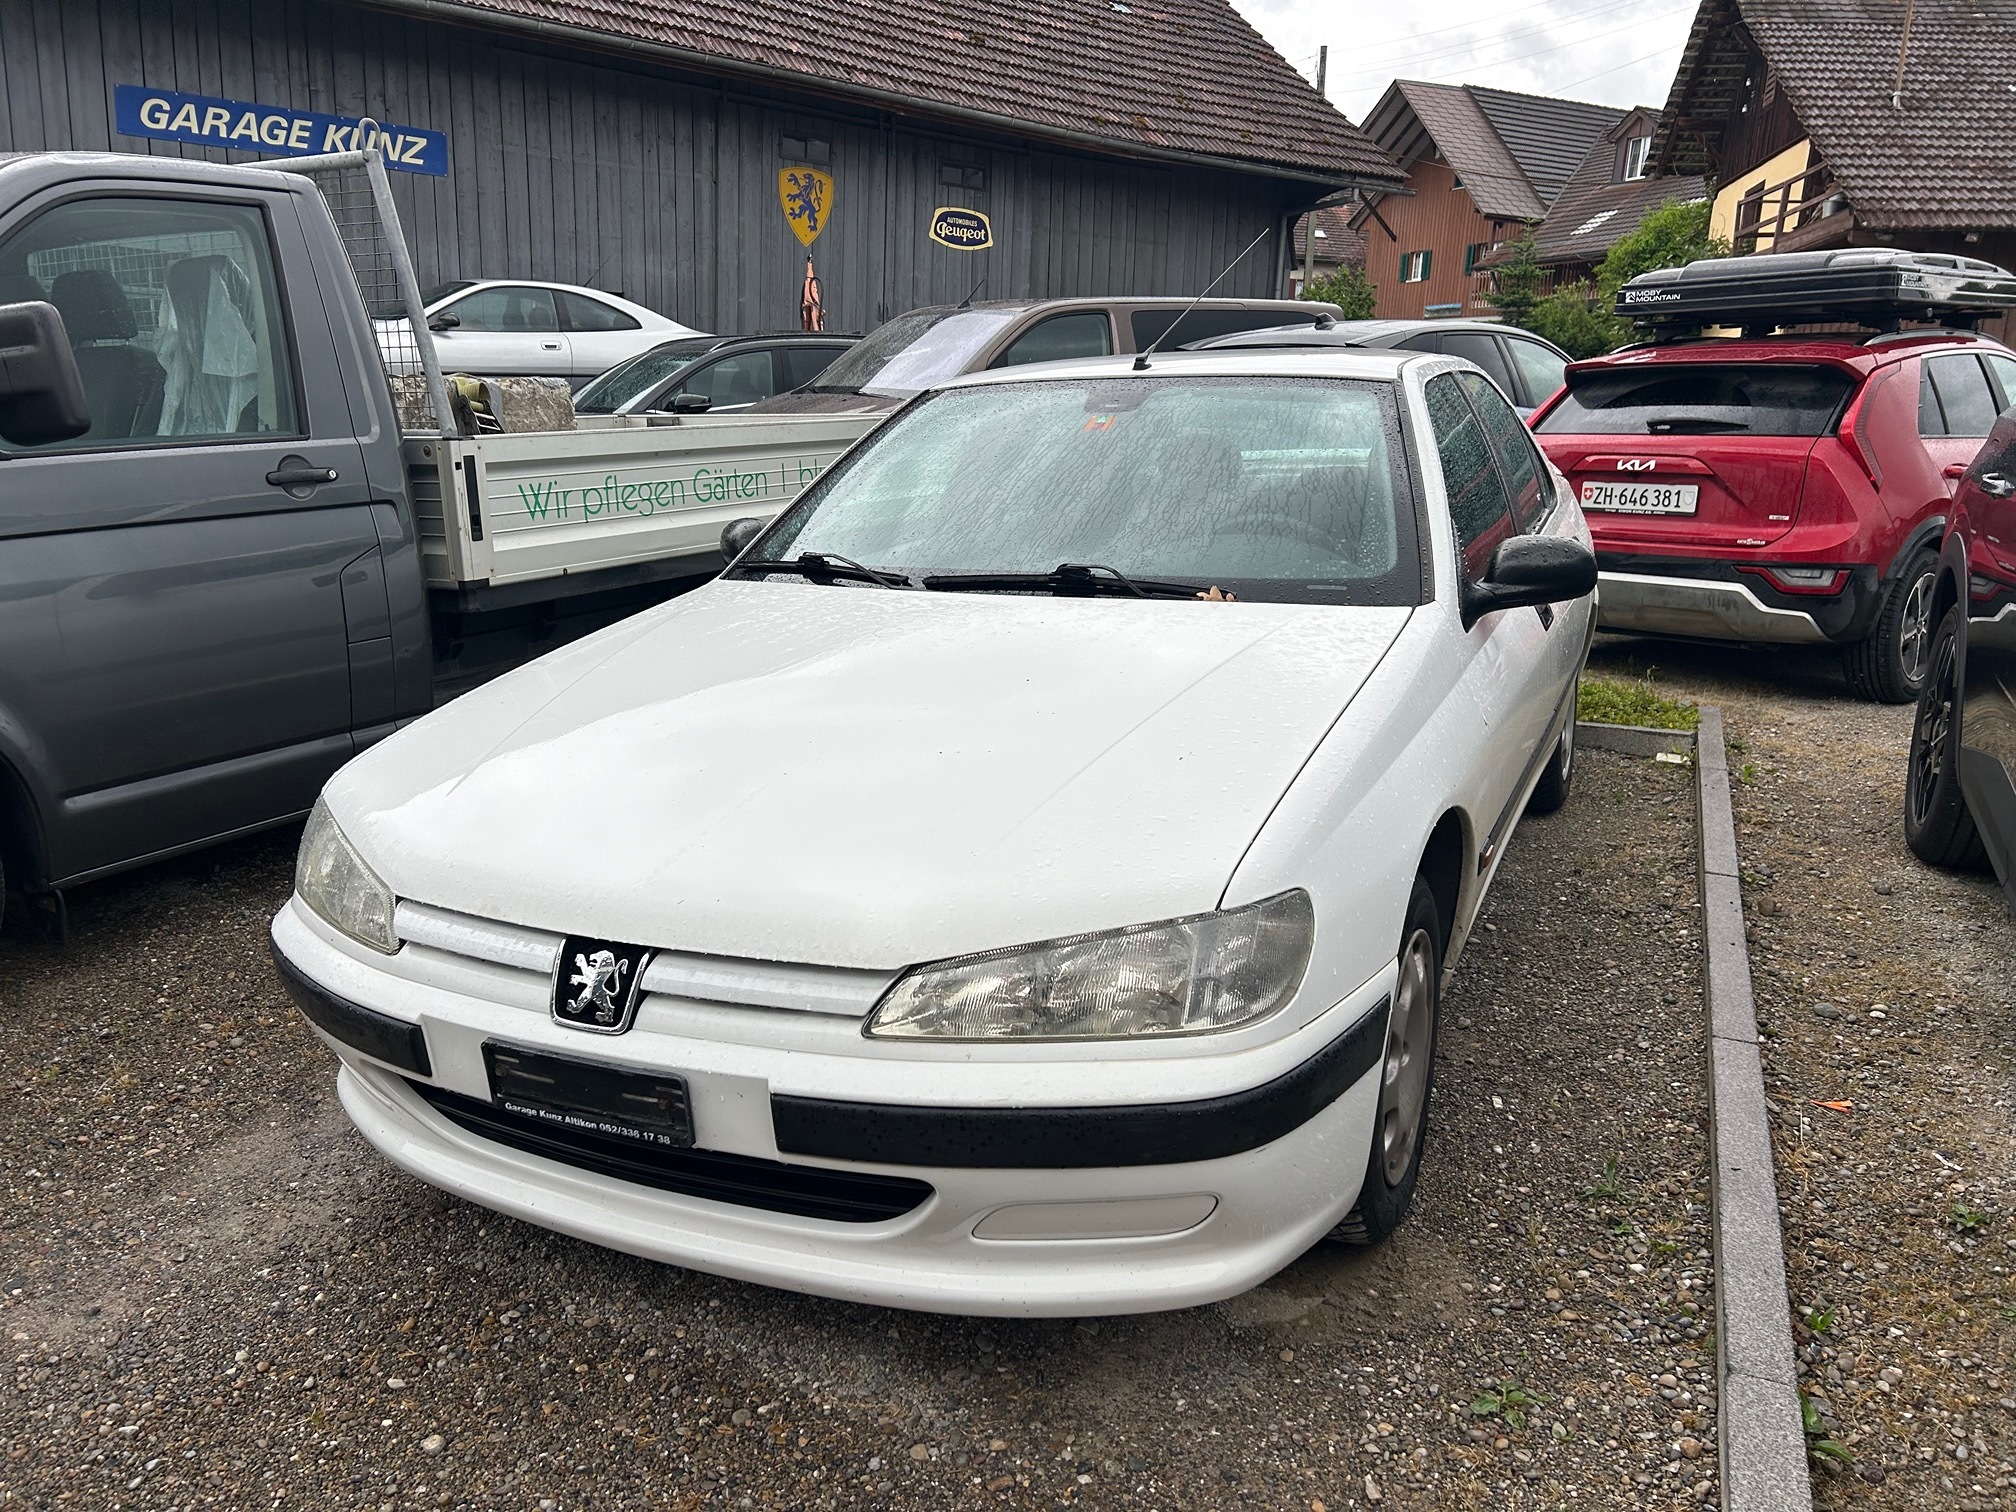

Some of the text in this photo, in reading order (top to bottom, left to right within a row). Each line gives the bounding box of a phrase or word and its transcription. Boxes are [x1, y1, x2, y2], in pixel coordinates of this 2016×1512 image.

[140, 98, 428, 165] GARAGE KUNZ
[946, 216, 978, 227] AUTOMOBILES
[936, 221, 986, 242] Peugeot
[1635, 289, 1662, 297] MOBY
[1635, 293, 1681, 303] MOUNTAIN
[1616, 459, 1656, 471] KIA
[517, 480, 572, 522] Wir
[582, 475, 686, 524] pflegen
[692, 468, 768, 503] Gärten
[504, 1101, 538, 1117] Garage
[539, 1109, 563, 1122] Kunz
[564, 1115, 598, 1130] Altikon
[642, 1131, 655, 1142] 17
[656, 1134, 671, 1145] 38
